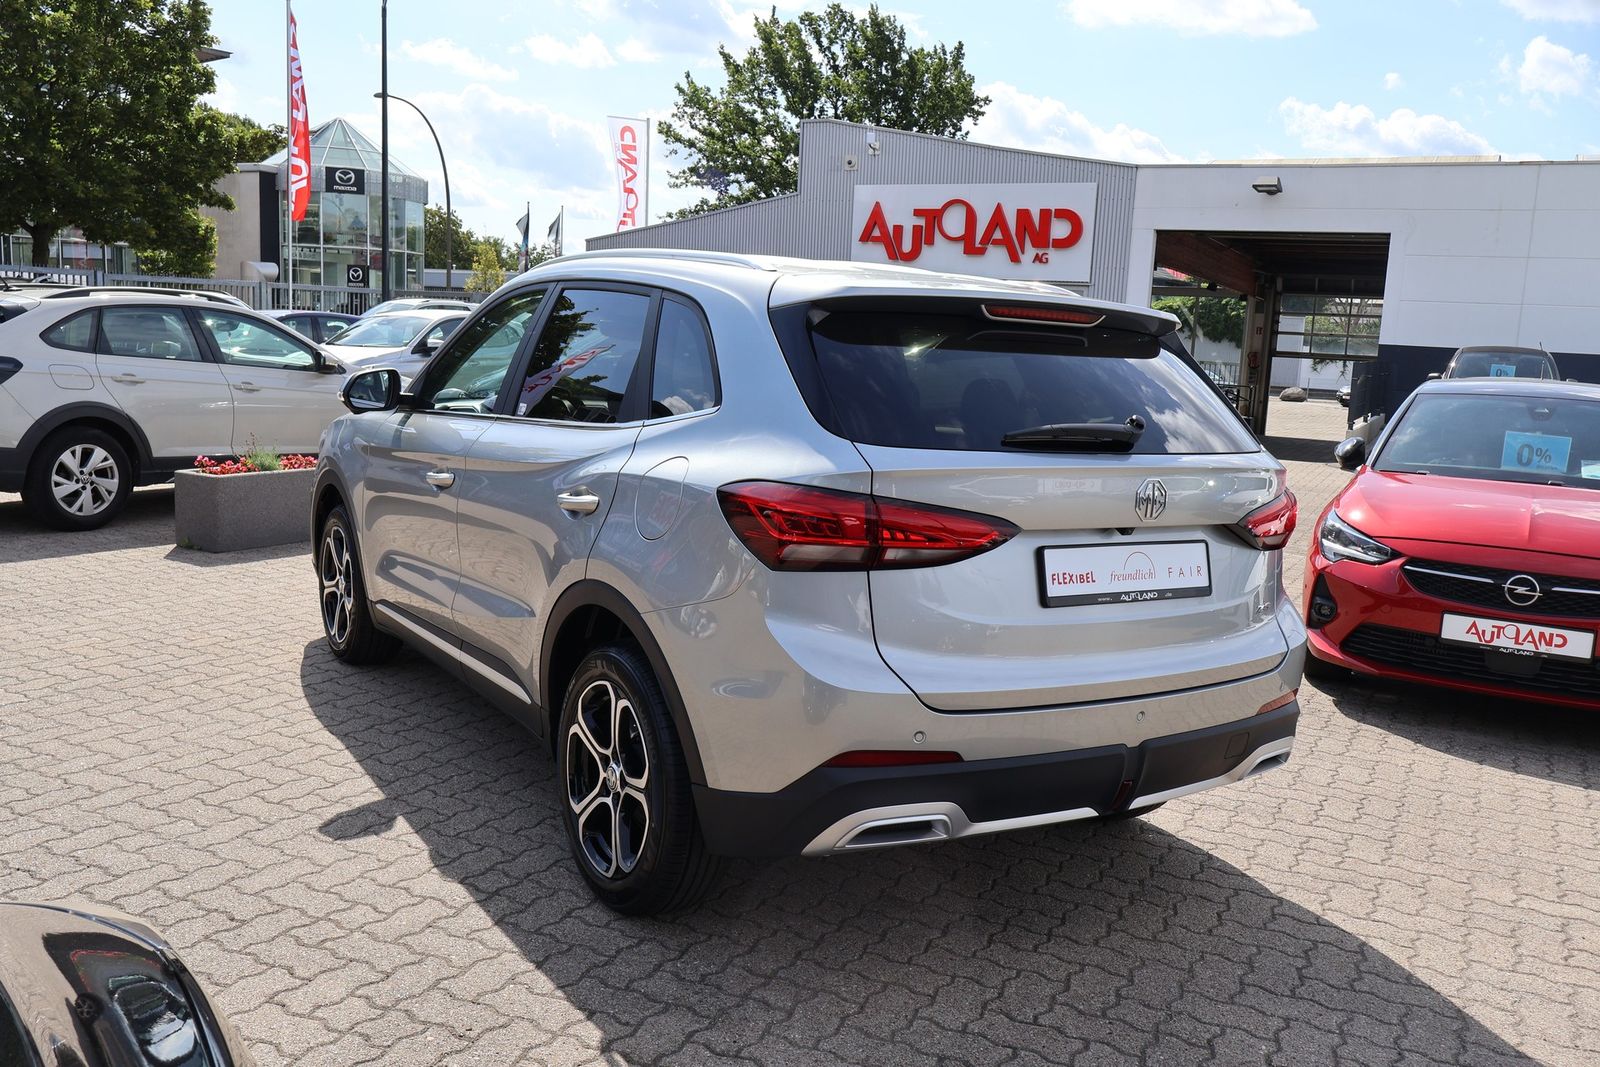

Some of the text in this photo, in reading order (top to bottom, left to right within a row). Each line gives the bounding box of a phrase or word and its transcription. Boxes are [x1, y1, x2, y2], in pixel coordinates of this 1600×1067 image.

[858, 198, 1084, 263] AUTOLAND
[1032, 252, 1049, 264] AG
[1517, 444, 1552, 467] 0%
[1138, 482, 1165, 518] MG
[1051, 571, 1096, 586] FLEXIBEL
[1108, 568, 1154, 585] freundlich
[1120, 591, 1158, 602] AUTOLAND
[1465, 620, 1568, 651] AUTOLAND
[1498, 647, 1534, 656] AUTOLAND
